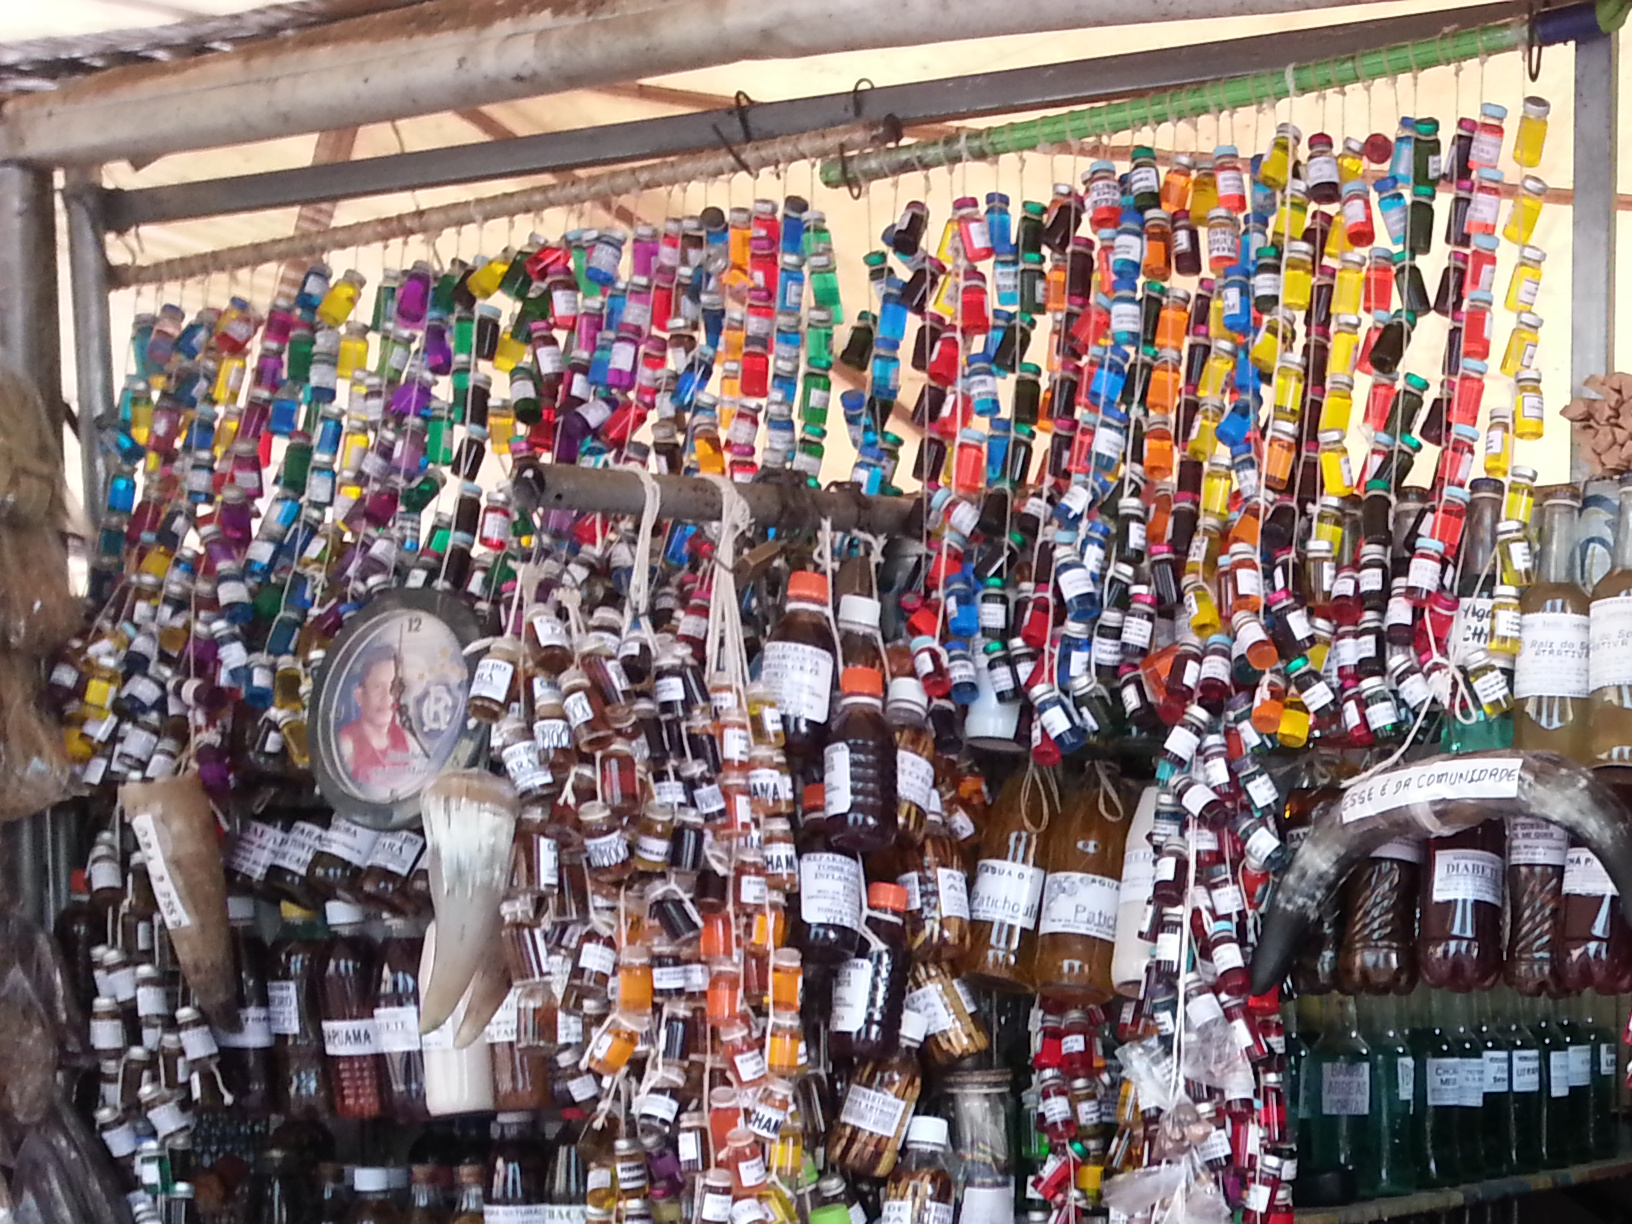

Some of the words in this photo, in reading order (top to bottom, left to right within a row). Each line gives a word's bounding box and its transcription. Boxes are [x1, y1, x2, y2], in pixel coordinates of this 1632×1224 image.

[407, 618, 422, 632] 12
[1342, 785, 1374, 811] ESSE
[1417, 767, 1519, 789] COMUNIDADE
[1446, 863, 1498, 875] DIABET
